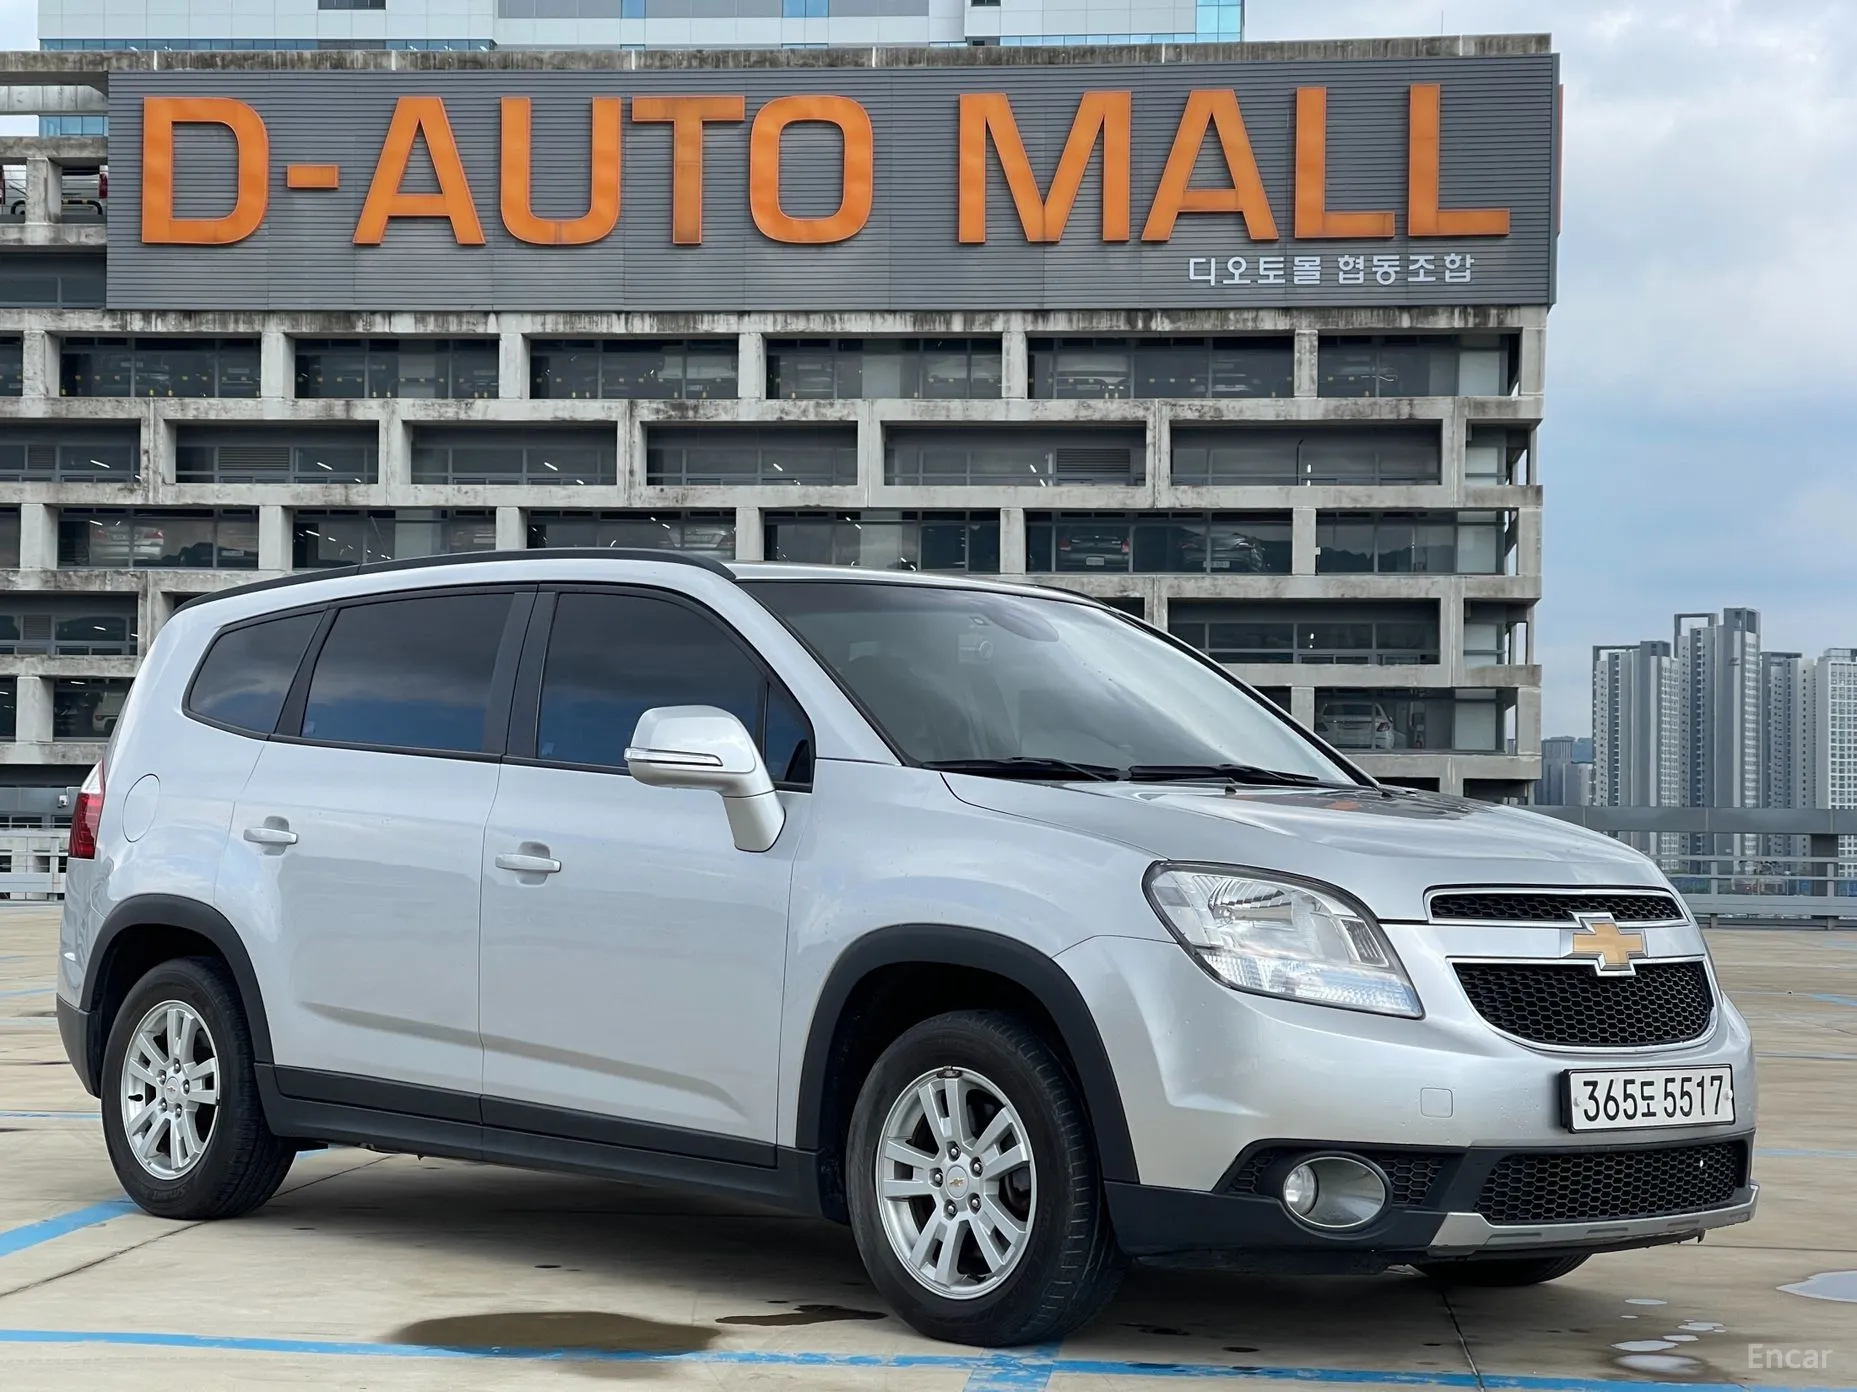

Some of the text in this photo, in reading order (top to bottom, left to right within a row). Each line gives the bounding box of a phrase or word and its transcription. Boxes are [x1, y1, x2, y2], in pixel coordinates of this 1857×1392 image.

[142, 84, 1511, 246] D-AUTO MALL
[1188, 253, 1475, 286] 디오토몰 협동조합
